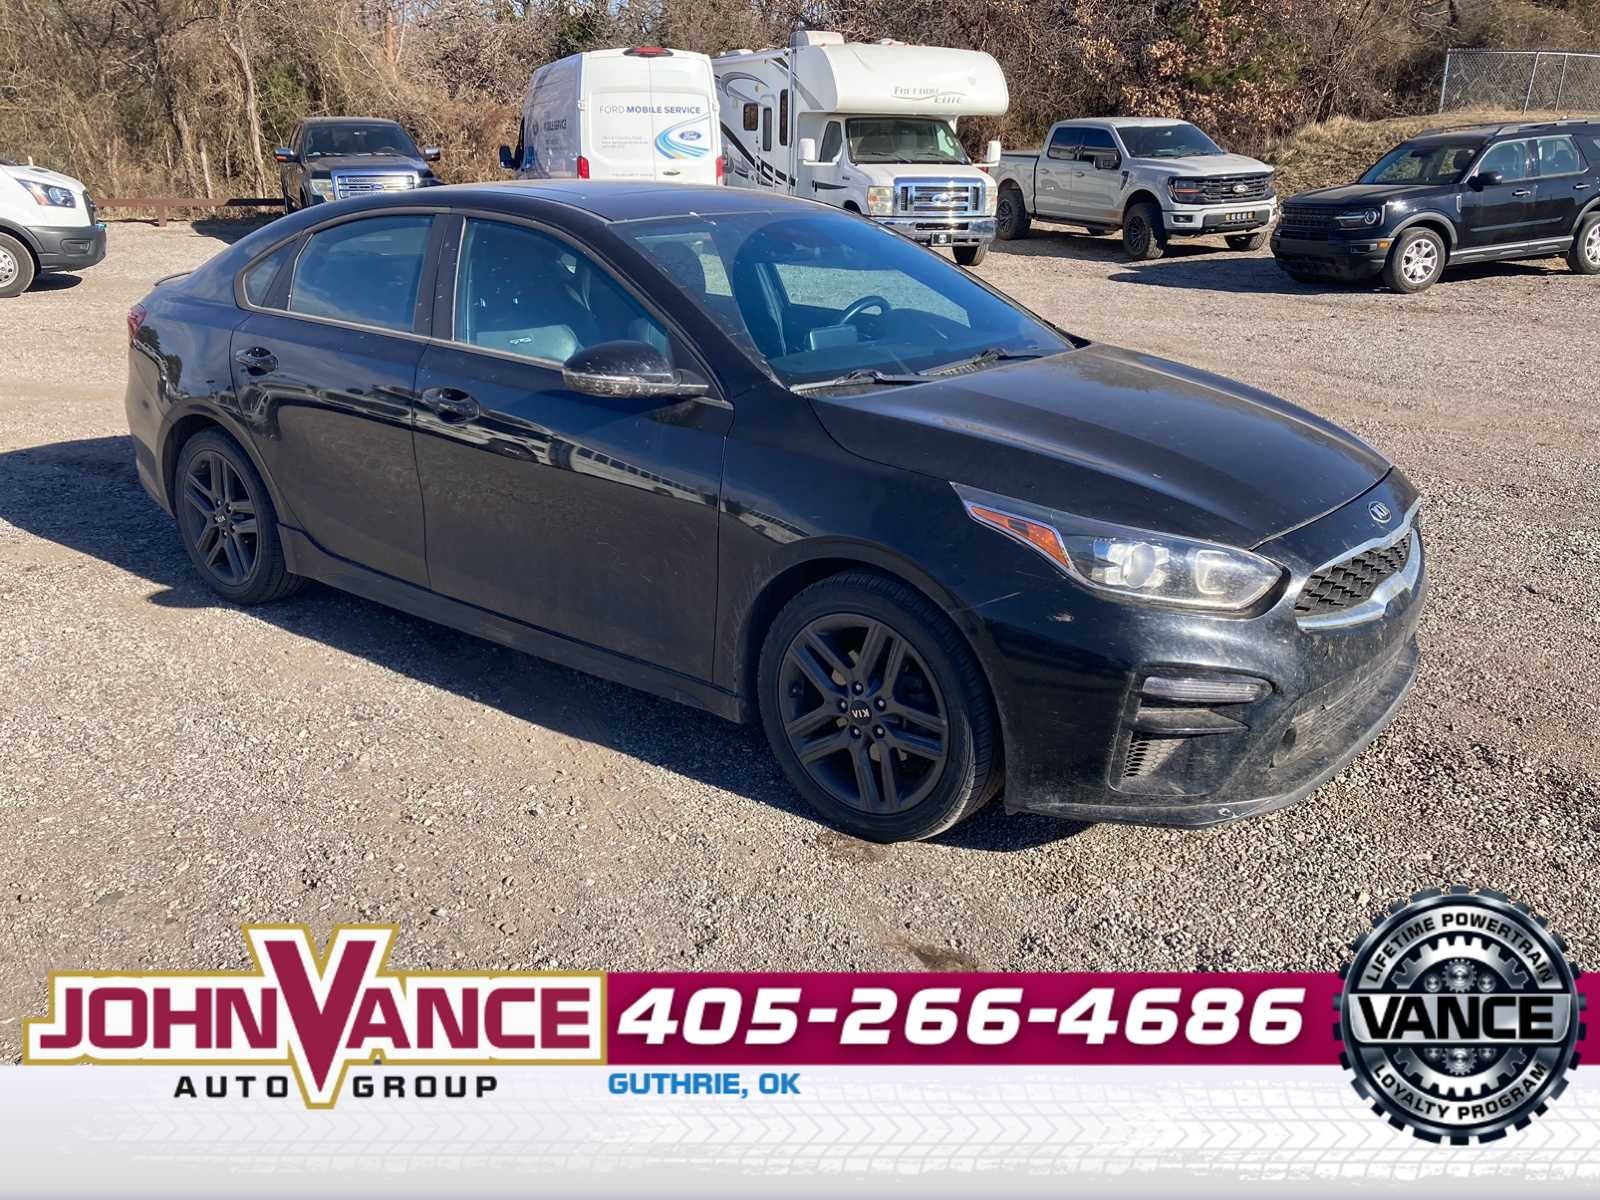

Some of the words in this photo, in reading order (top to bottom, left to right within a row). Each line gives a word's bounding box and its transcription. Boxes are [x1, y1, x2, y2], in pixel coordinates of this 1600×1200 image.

[600, 105, 625, 114] FORD
[626, 106, 662, 114] MOBILE
[664, 106, 701, 114] SERVICE
[851, 708, 870, 718] KIA
